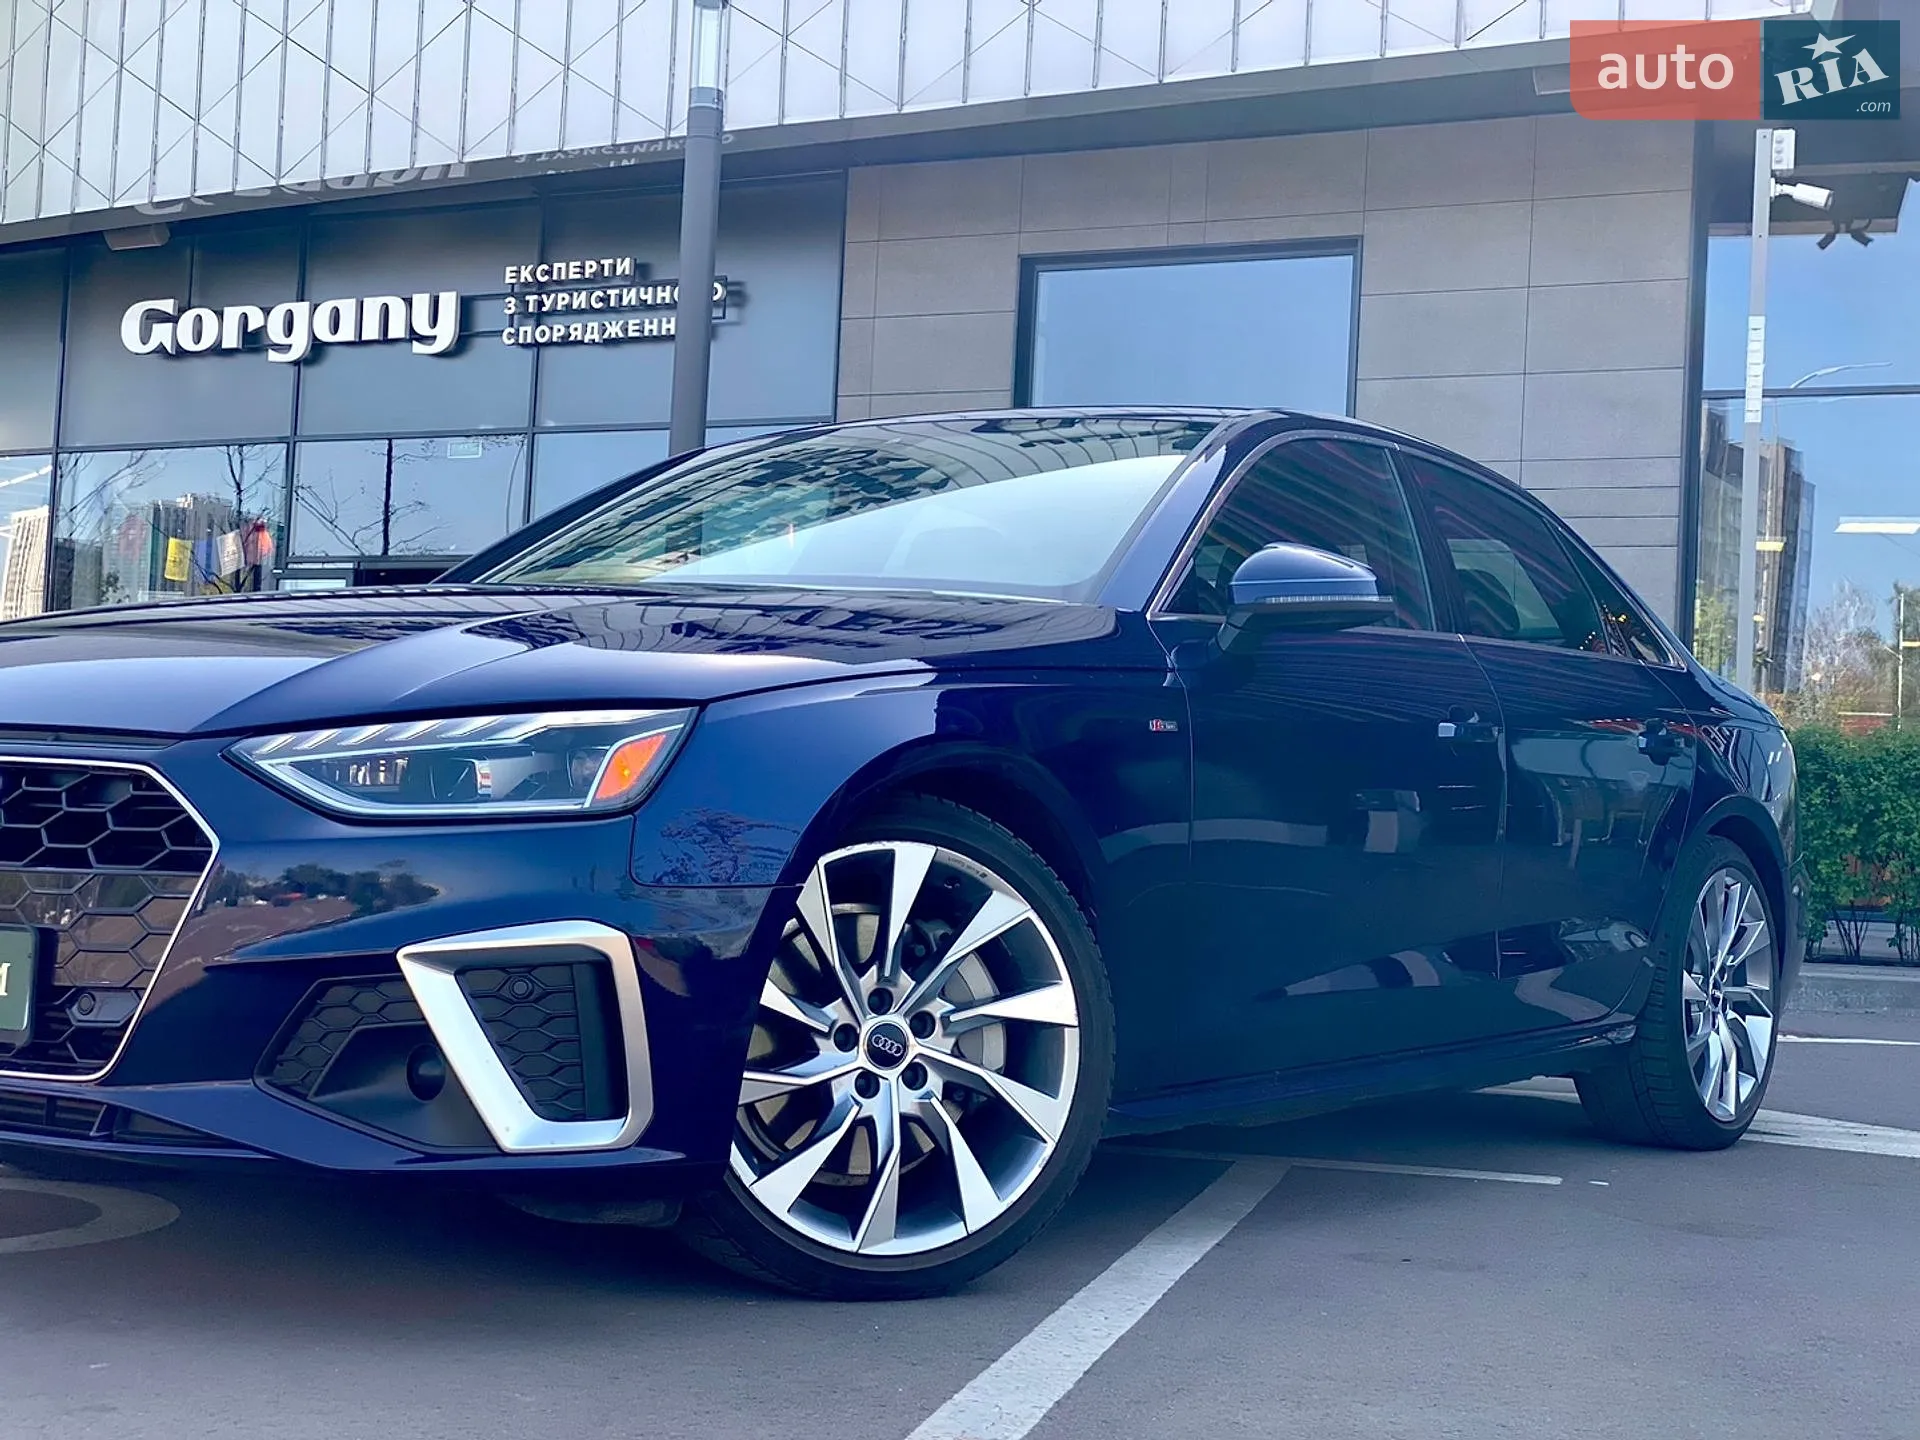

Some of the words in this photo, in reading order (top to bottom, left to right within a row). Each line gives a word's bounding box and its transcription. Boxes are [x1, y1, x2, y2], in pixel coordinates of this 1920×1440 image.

[504, 257, 633, 284] ЕКСПЕРТИ
[504, 296, 516, 315] З
[526, 282, 724, 313] ТУРИСТИЧНО
[120, 291, 459, 363] Gorgany
[502, 317, 676, 345] СПОРЯДЖЕНН
